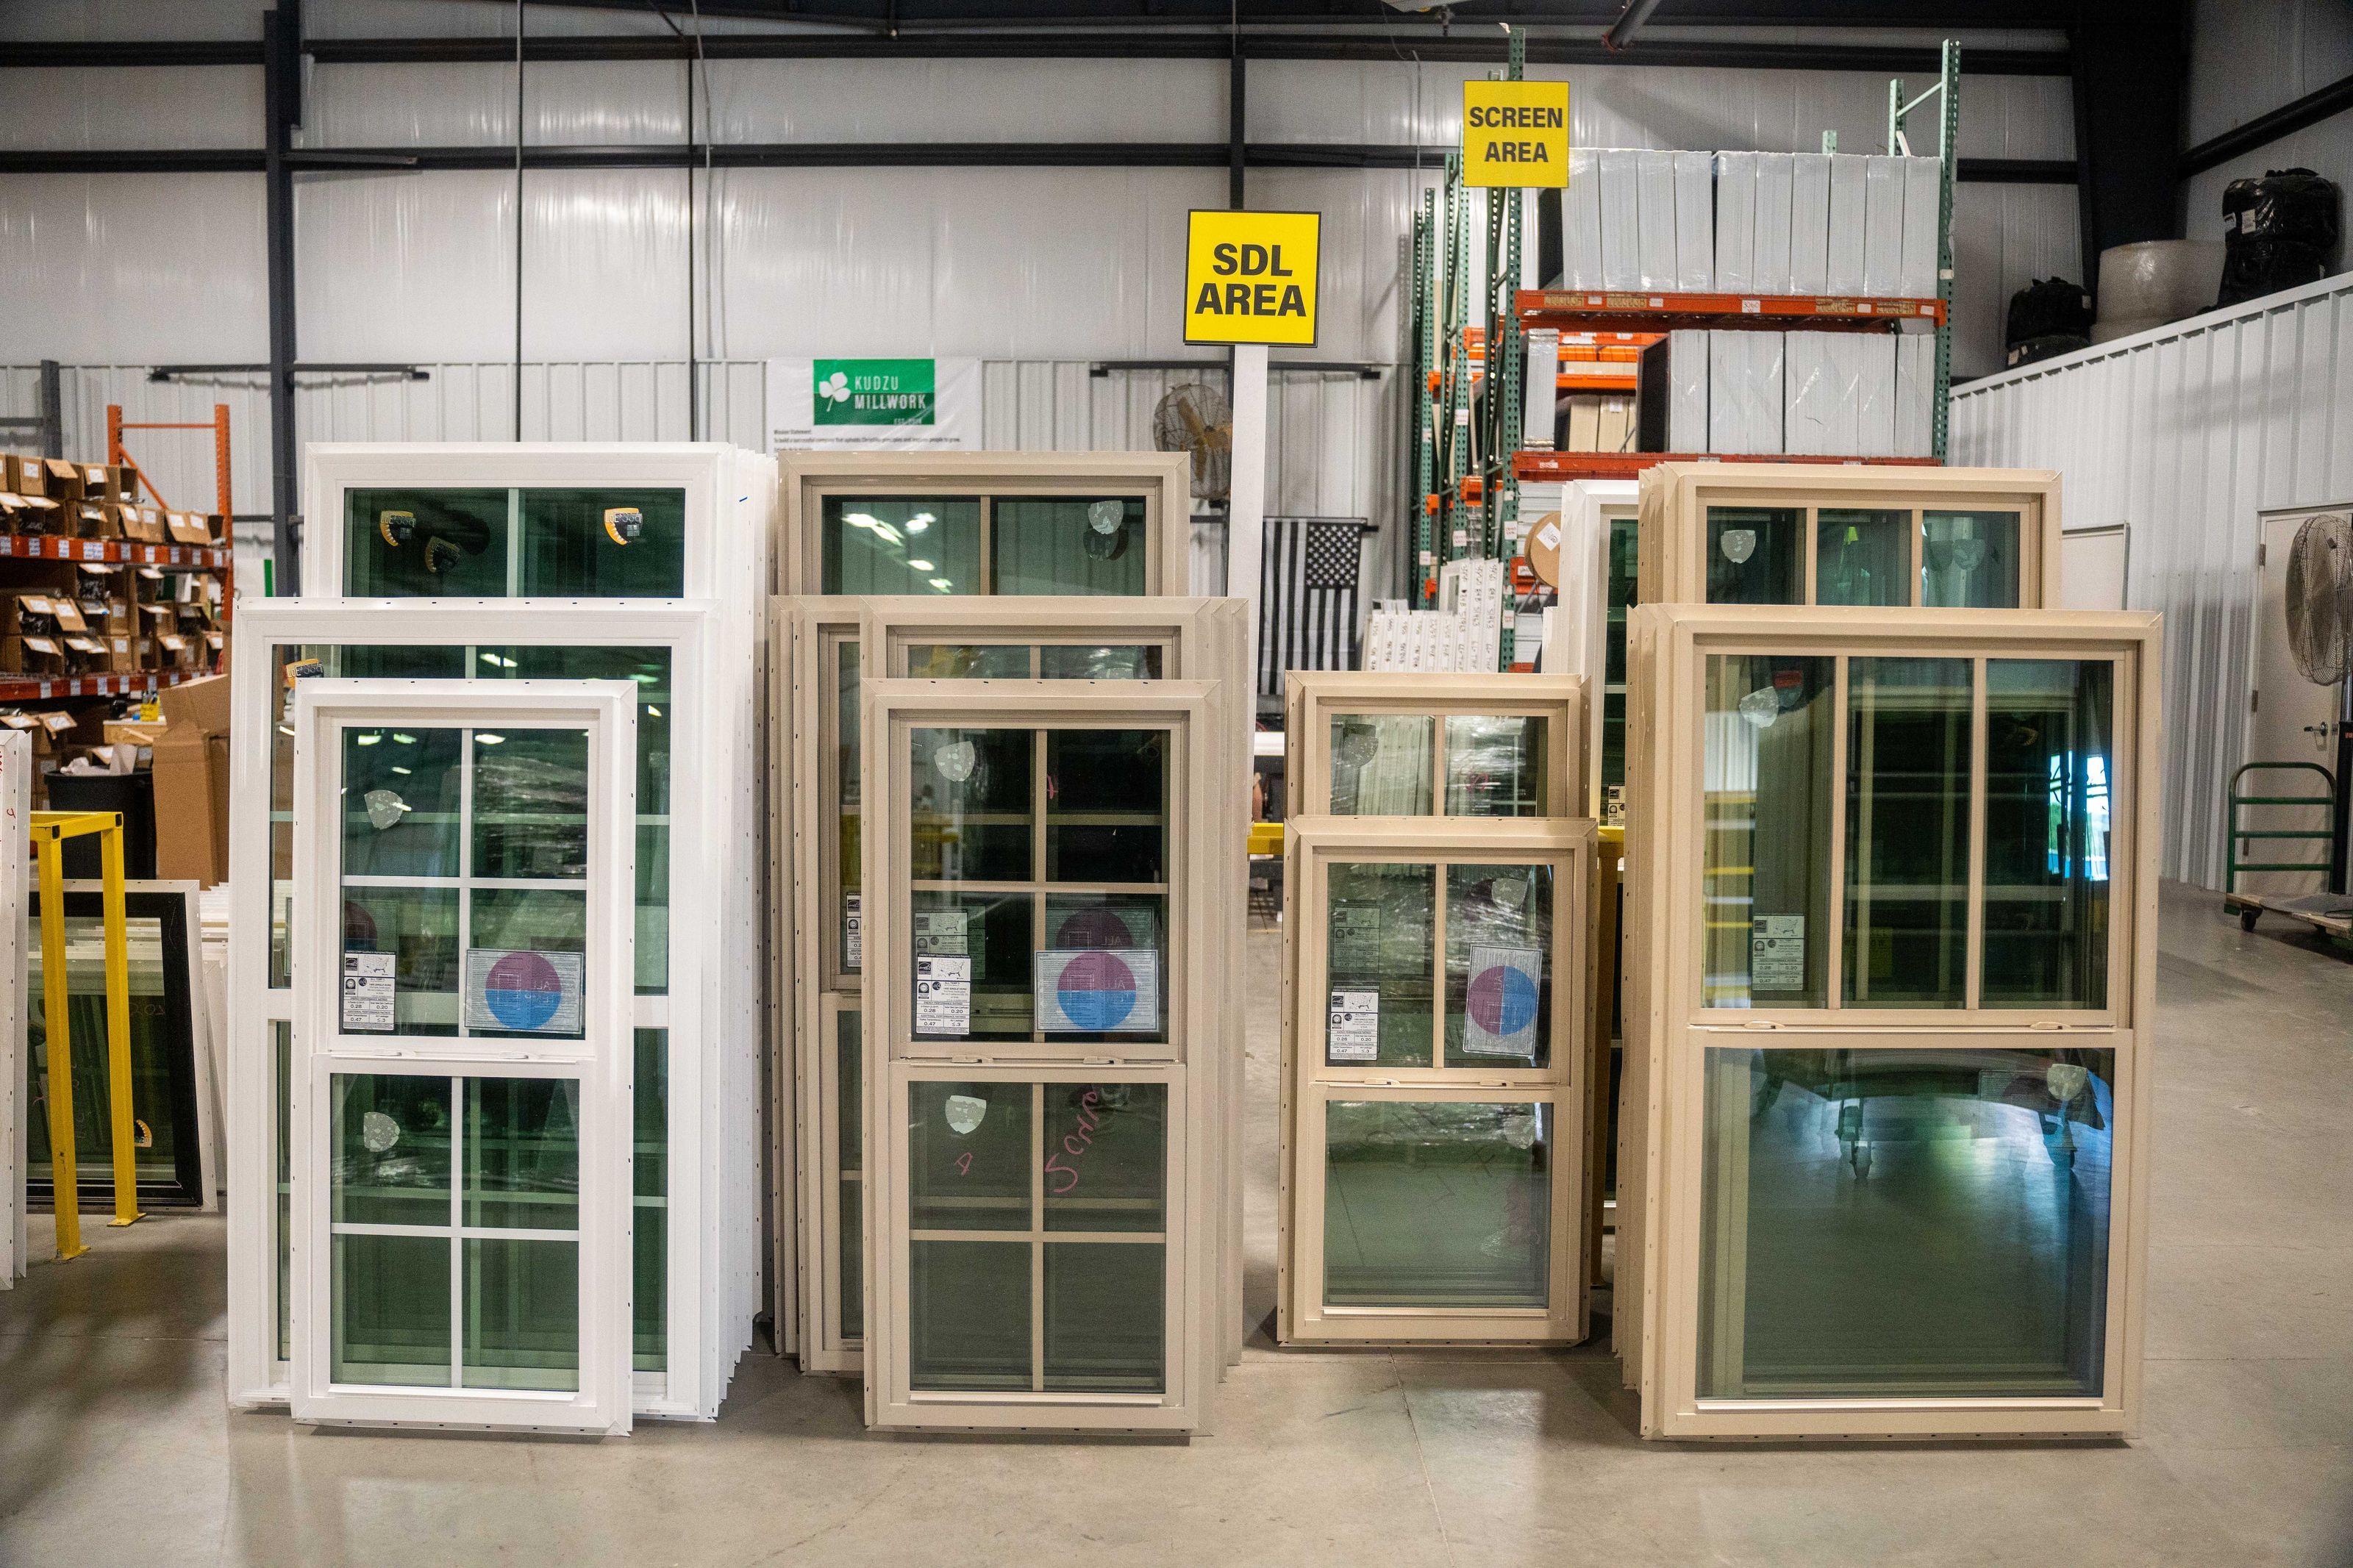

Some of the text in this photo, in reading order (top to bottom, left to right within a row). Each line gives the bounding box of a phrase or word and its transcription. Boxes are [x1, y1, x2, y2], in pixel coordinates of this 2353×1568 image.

[1469, 107, 1563, 128] SCREEN
[1485, 141, 1549, 162] AREA
[1213, 243, 1293, 276] SDL
[1194, 282, 1307, 317] AREA
[854, 376, 899, 390] KUDZU
[854, 394, 926, 409] MILLWORK
